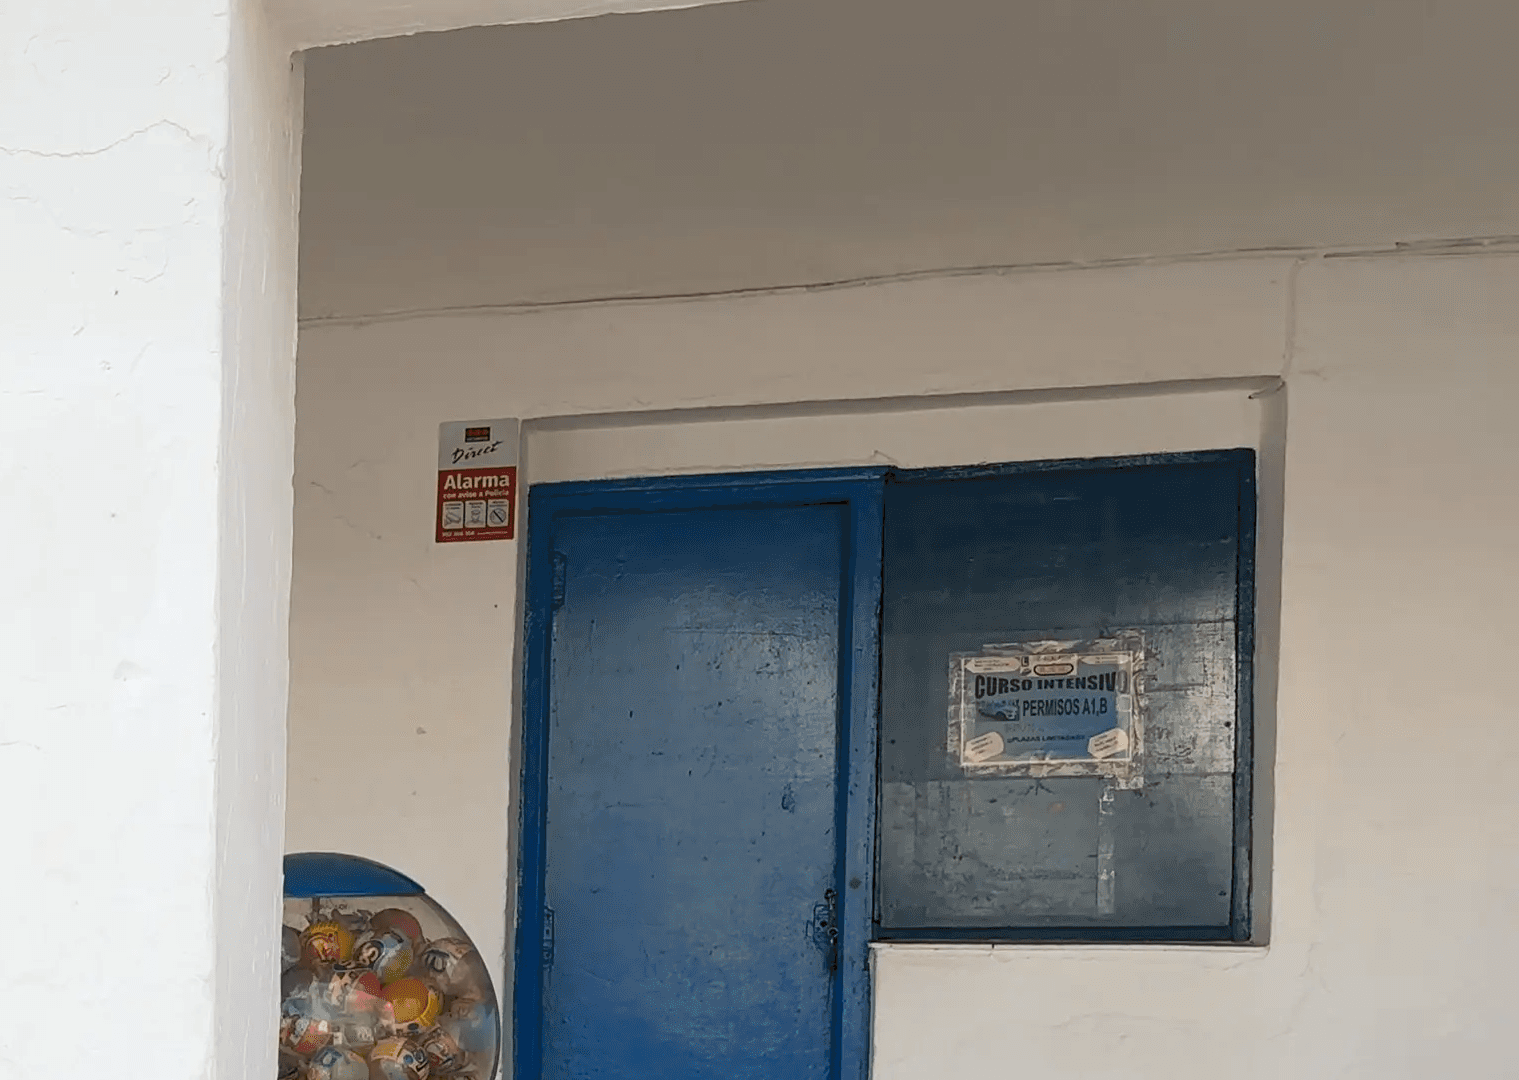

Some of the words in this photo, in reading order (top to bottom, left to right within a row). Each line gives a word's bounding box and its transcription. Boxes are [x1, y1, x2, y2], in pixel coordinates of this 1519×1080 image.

[451, 440, 503, 465] Direct
[443, 473, 509, 490] Alarma
[974, 674, 1033, 699] CURSO
[1022, 698, 1081, 716] PERMISOS
